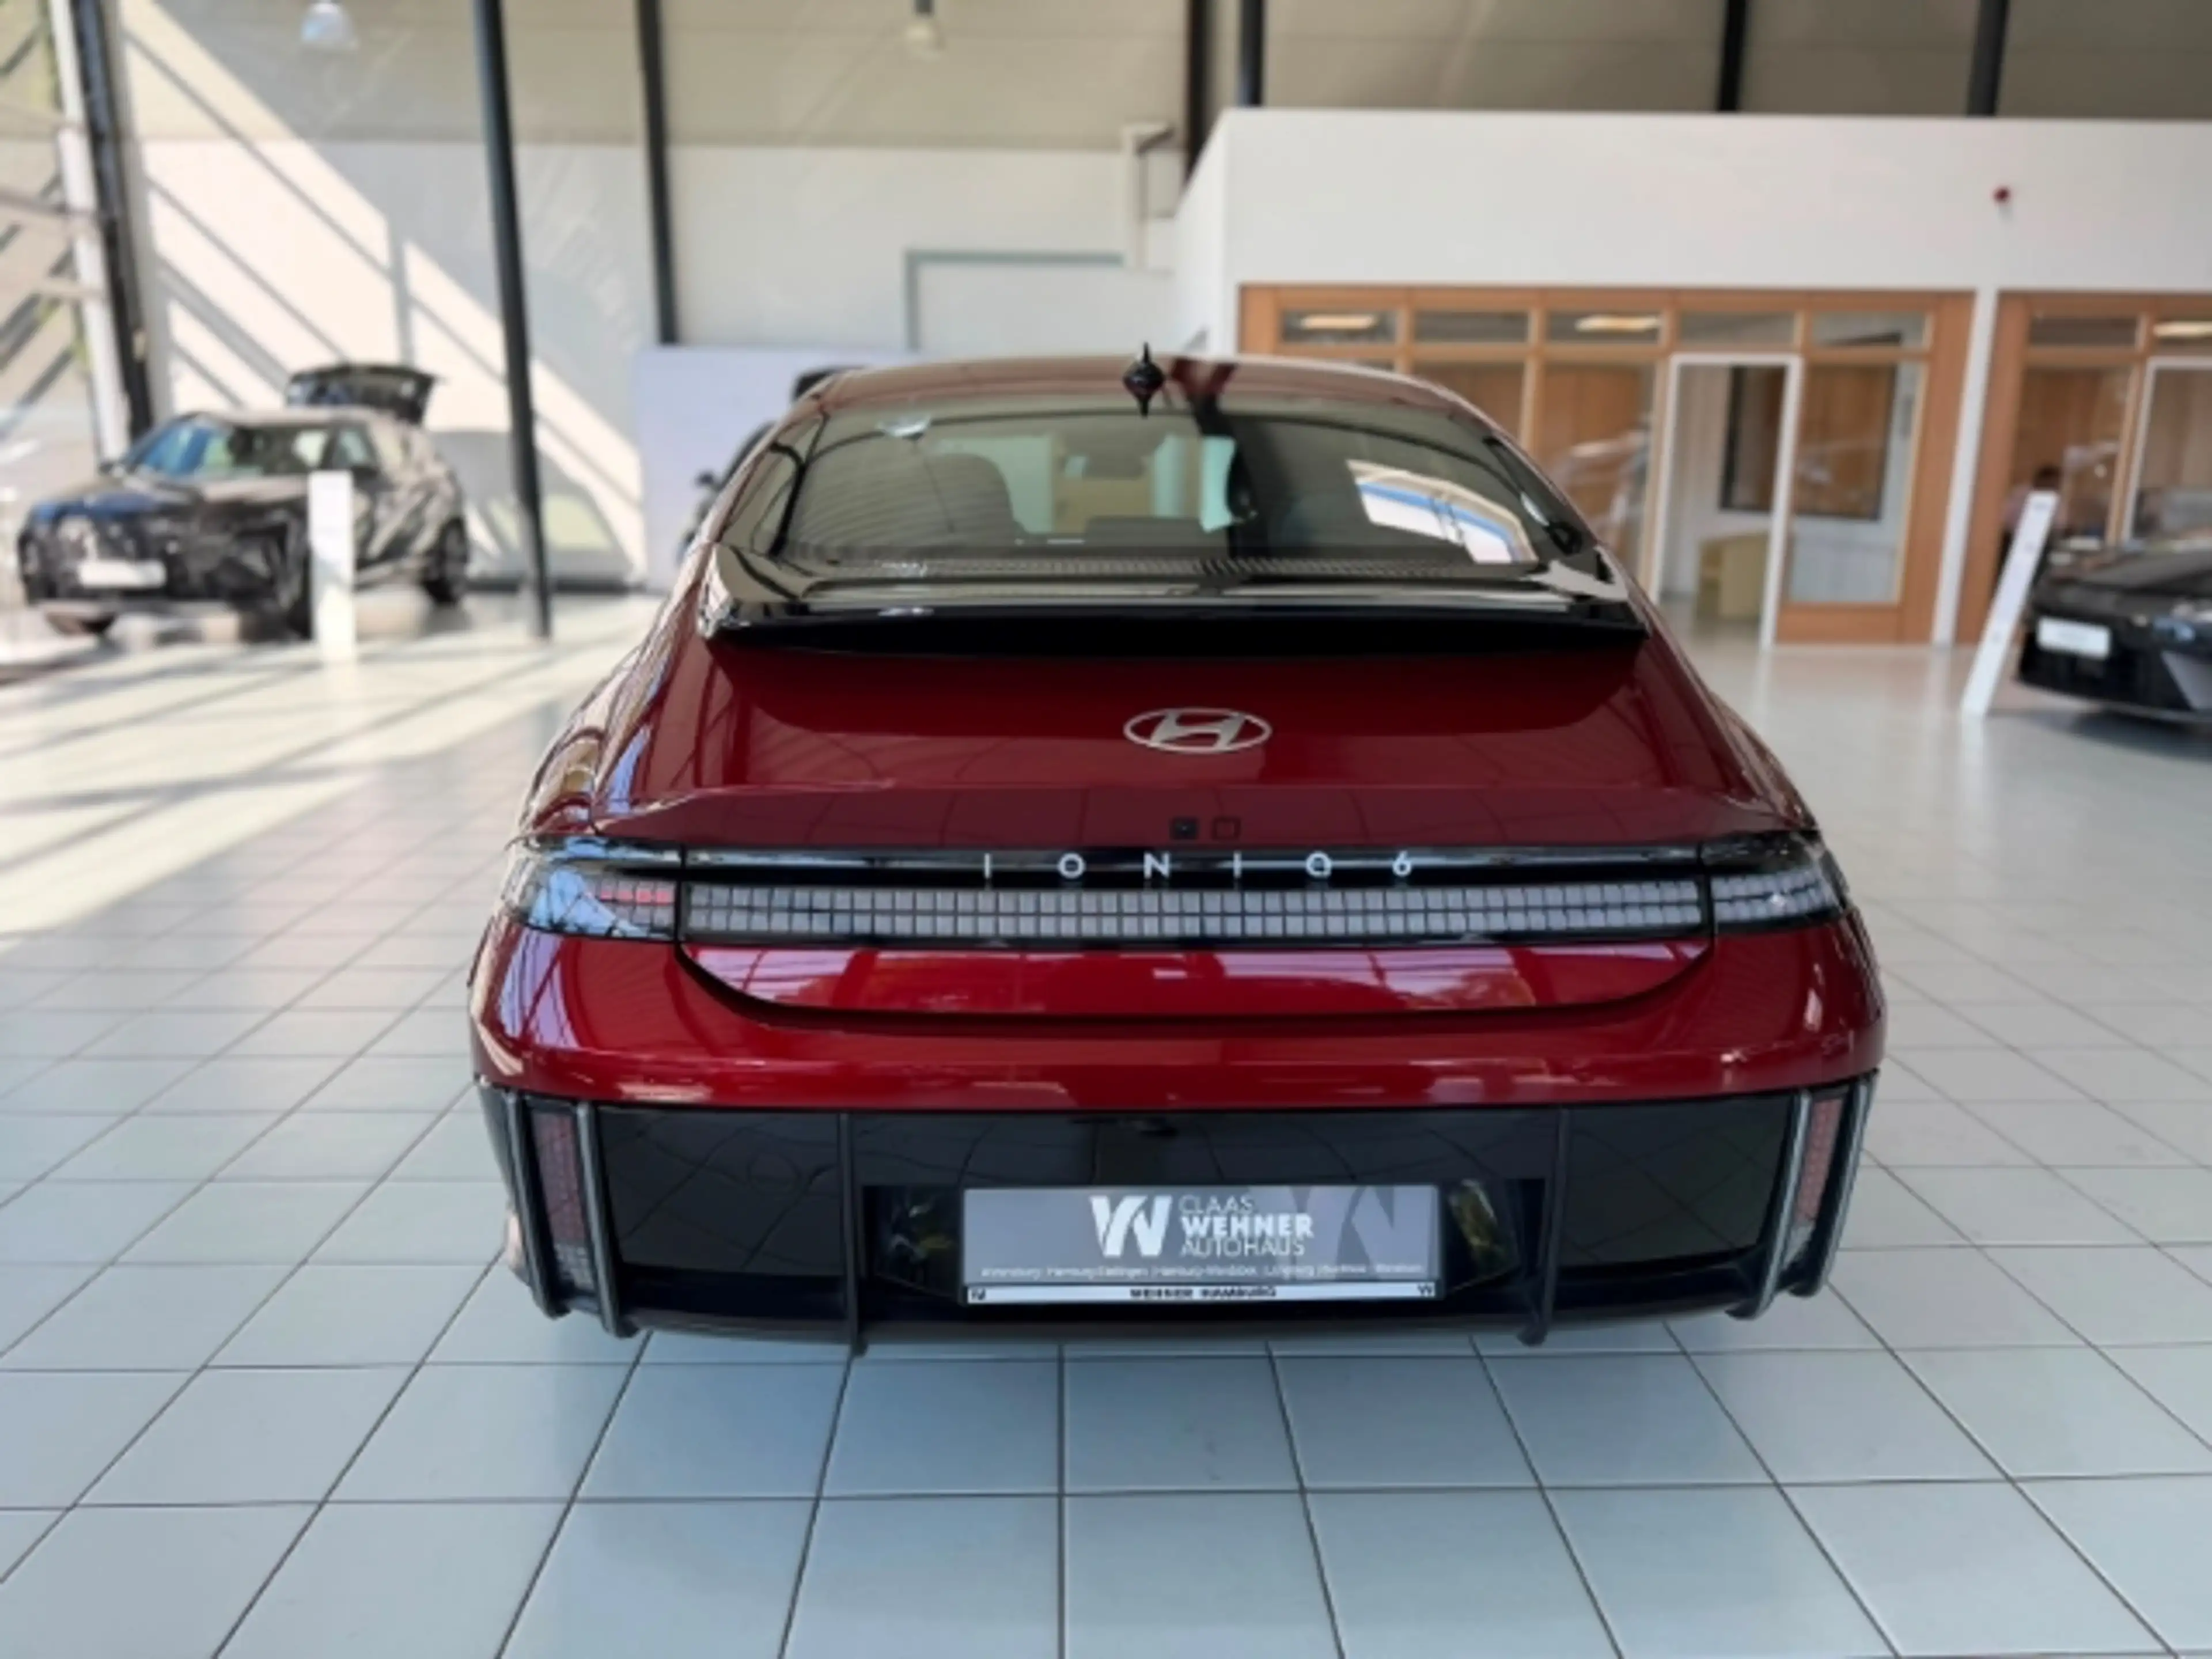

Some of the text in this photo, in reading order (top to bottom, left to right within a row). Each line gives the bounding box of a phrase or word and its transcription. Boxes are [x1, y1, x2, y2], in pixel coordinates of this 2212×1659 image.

[1179, 1195, 1255, 1214] CLAAS
[1181, 1214, 1313, 1238] WEHNER
[1181, 1237, 1305, 1257] AUTOHAUS
